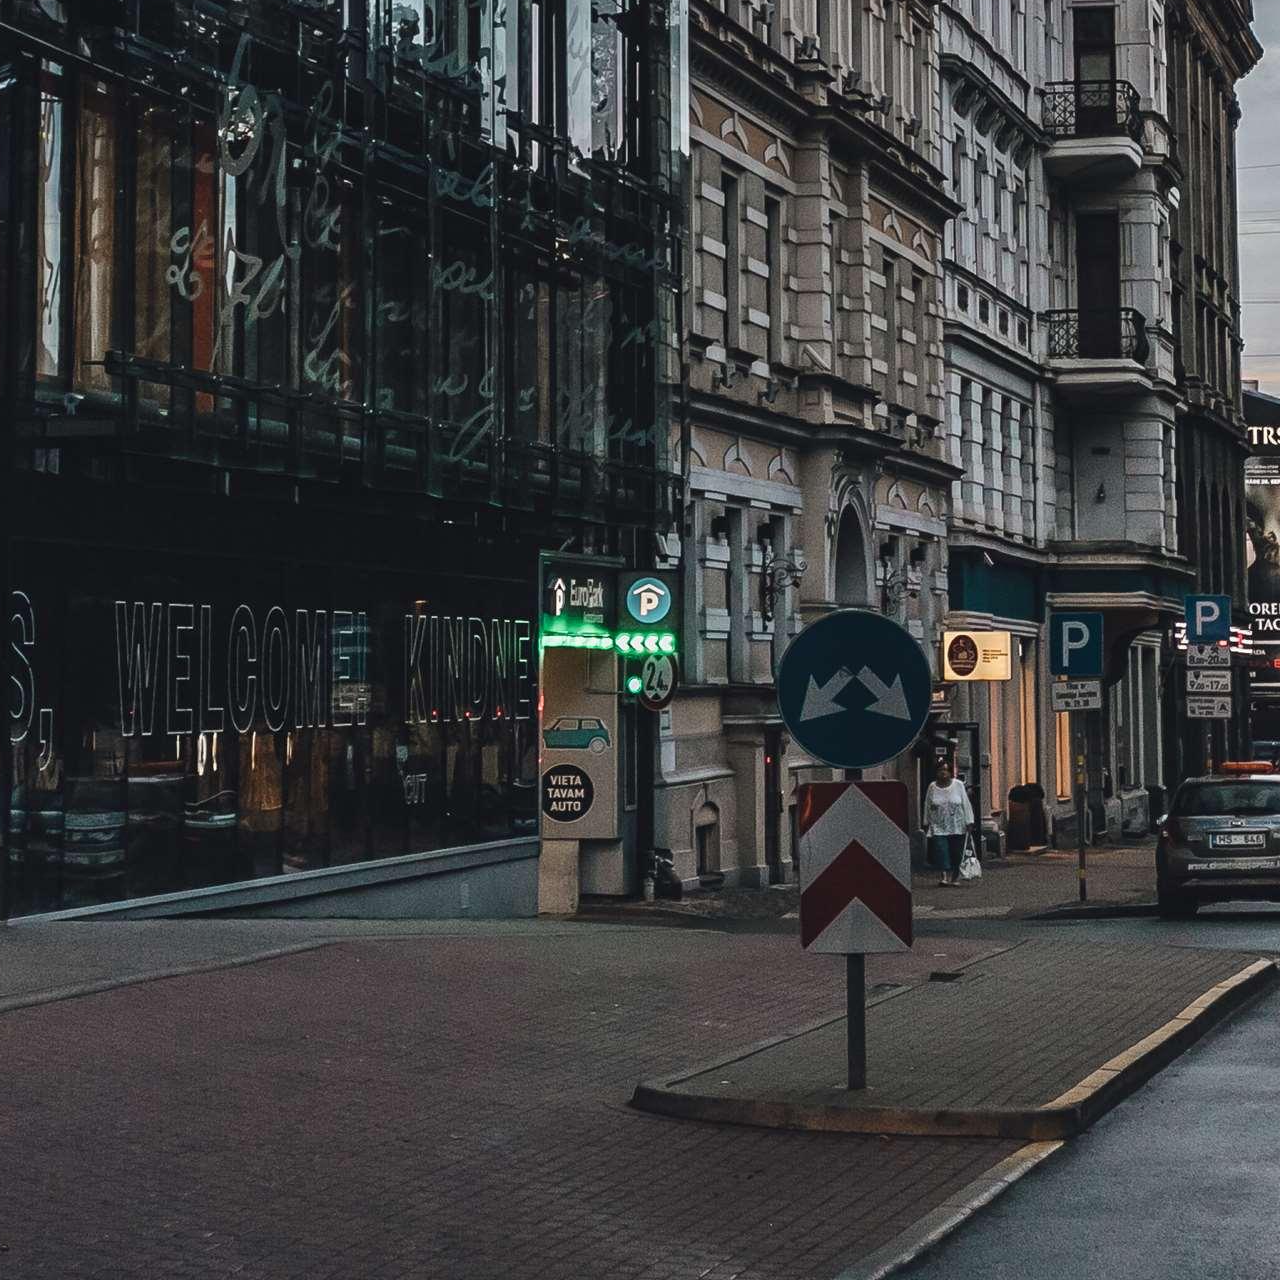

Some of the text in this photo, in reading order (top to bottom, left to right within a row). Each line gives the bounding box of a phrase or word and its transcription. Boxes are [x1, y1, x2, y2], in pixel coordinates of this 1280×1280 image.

[640, 591, 659, 616] P
[1196, 601, 1220, 635] P
[1062, 621, 1090, 667] P
[405, 614, 535, 724] KINDNE
[550, 775, 582, 786] VIETA
[547, 788, 585, 799] TAVAM
[550, 801, 581, 812] AUTO
